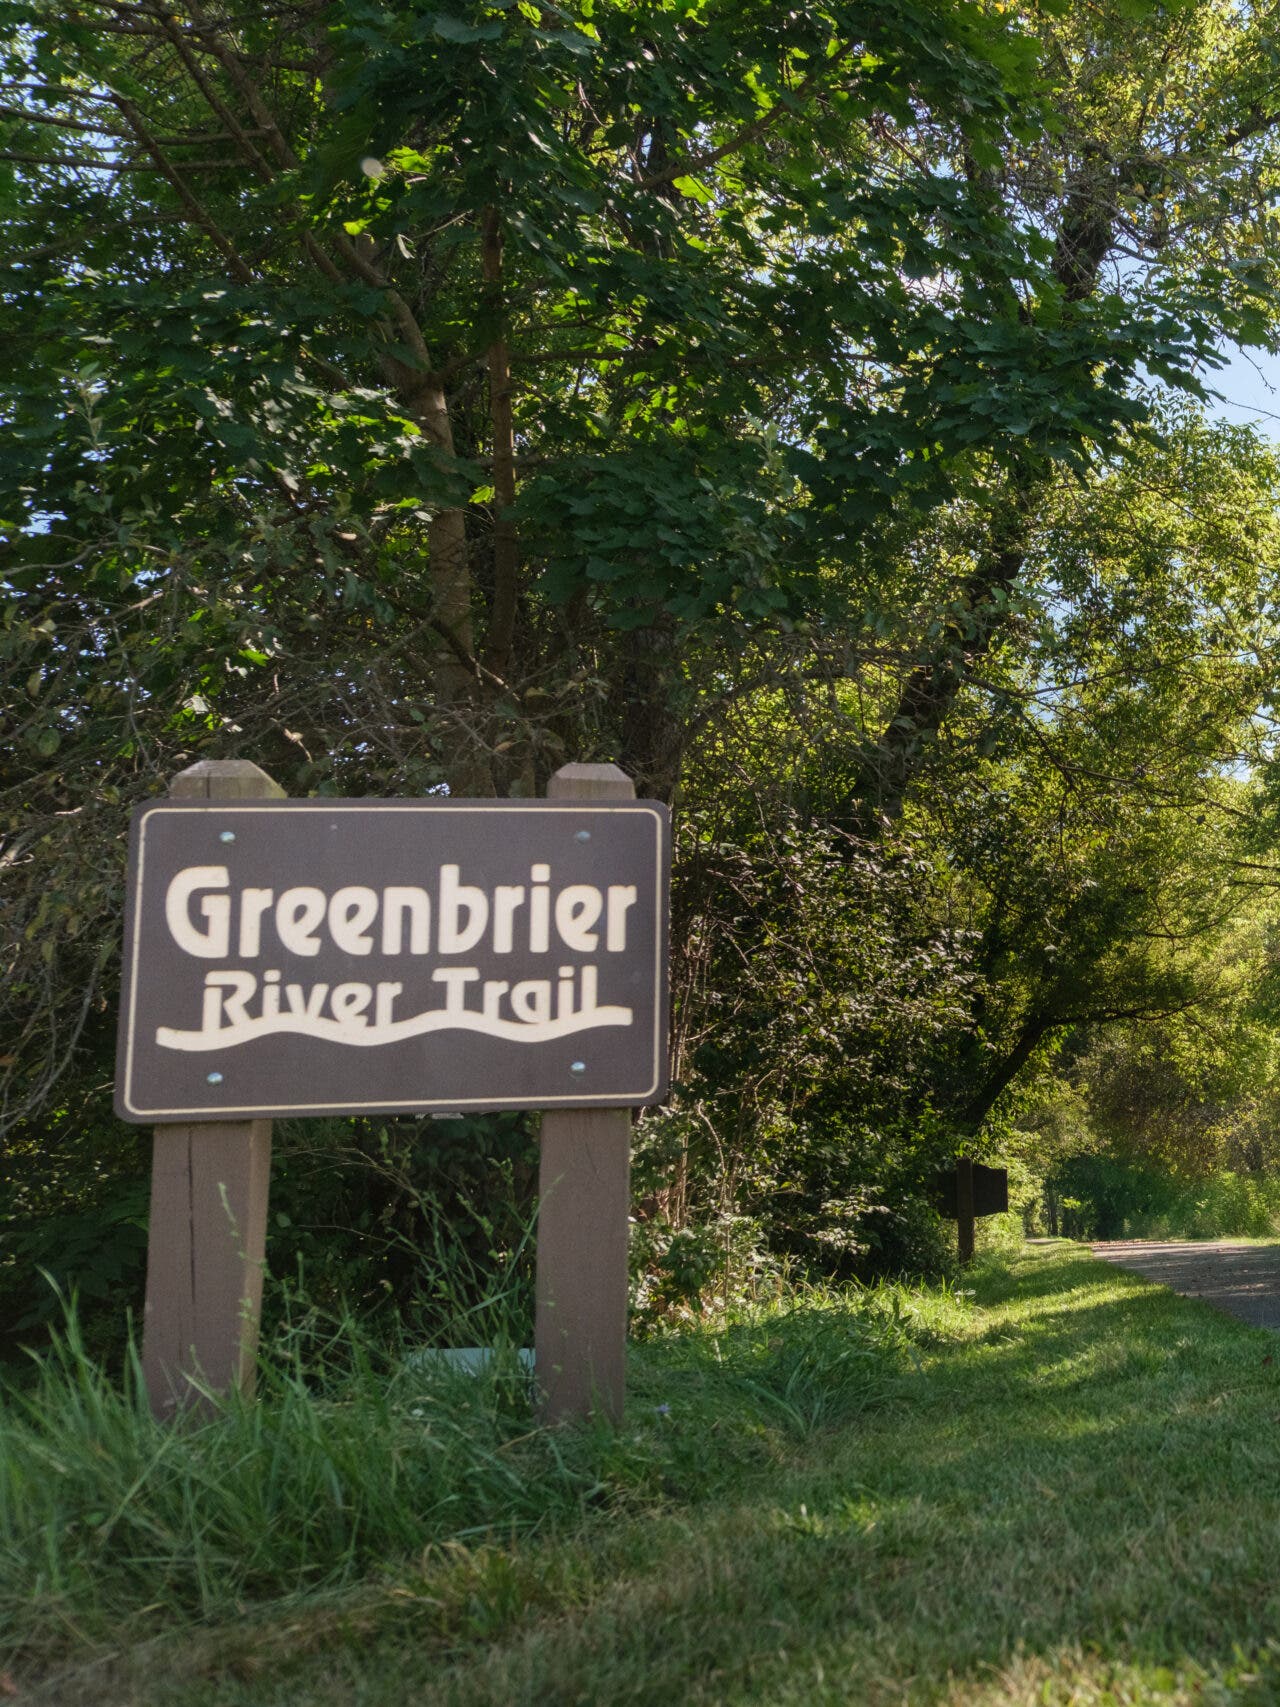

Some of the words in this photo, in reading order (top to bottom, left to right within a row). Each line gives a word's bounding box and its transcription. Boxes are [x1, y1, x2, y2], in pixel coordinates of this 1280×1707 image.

[166, 863, 637, 958] Greenbrier
[202, 970, 403, 1032] River
[431, 965, 598, 1025] Trail
